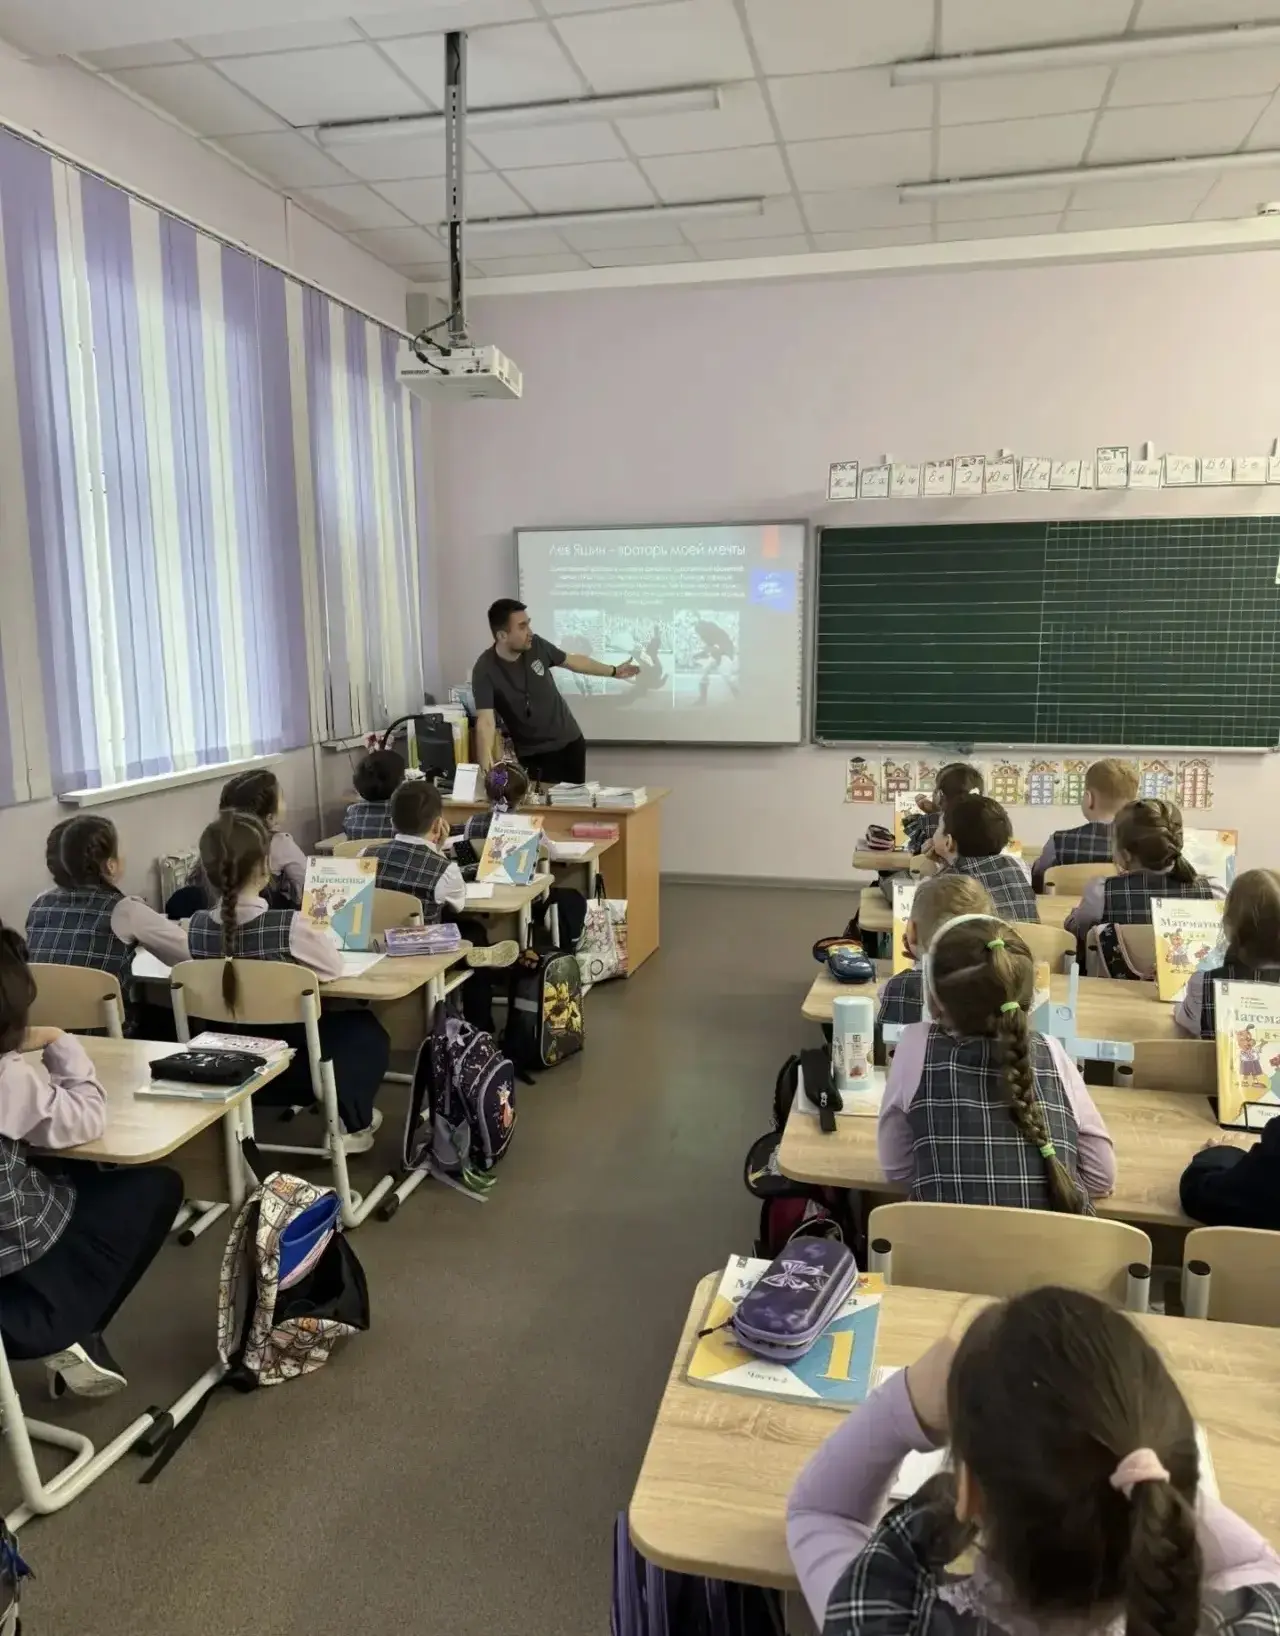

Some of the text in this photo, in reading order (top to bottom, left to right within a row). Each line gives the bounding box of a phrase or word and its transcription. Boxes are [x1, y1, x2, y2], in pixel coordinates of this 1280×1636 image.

[573, 543, 606, 557] Яшин
[669, 541, 704, 557] моей
[707, 545, 746, 557] мечты
[515, 849, 530, 874] 1
[310, 876, 366, 885] Математика
[348, 902, 364, 937] 1
[1160, 917, 1223, 930] Математик
[1226, 1008, 1280, 1024] Матема
[816, 1330, 860, 1382] 1
[747, 1371, 779, 1383] Часть
